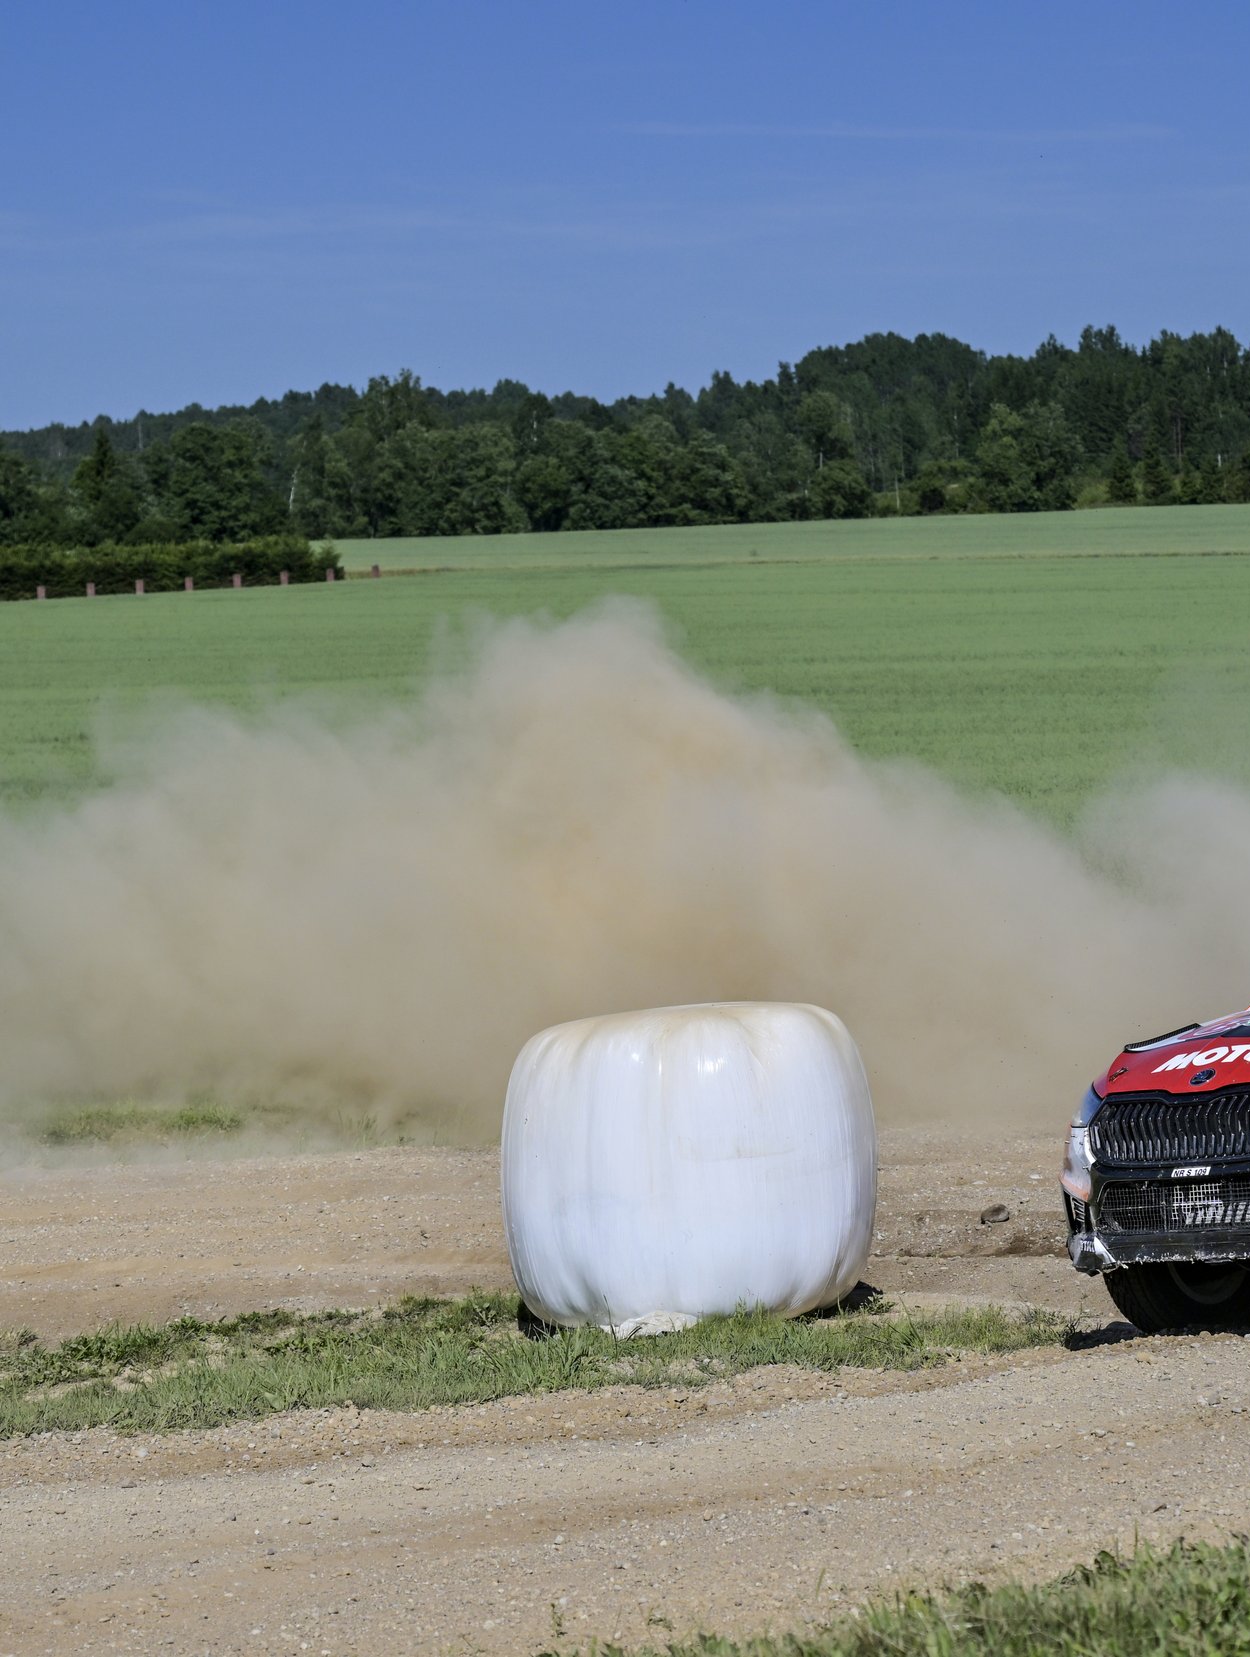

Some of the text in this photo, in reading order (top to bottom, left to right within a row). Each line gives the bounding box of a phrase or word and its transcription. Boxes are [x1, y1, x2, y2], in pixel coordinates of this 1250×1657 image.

[1173, 1167, 1207, 1178] NR S 109
